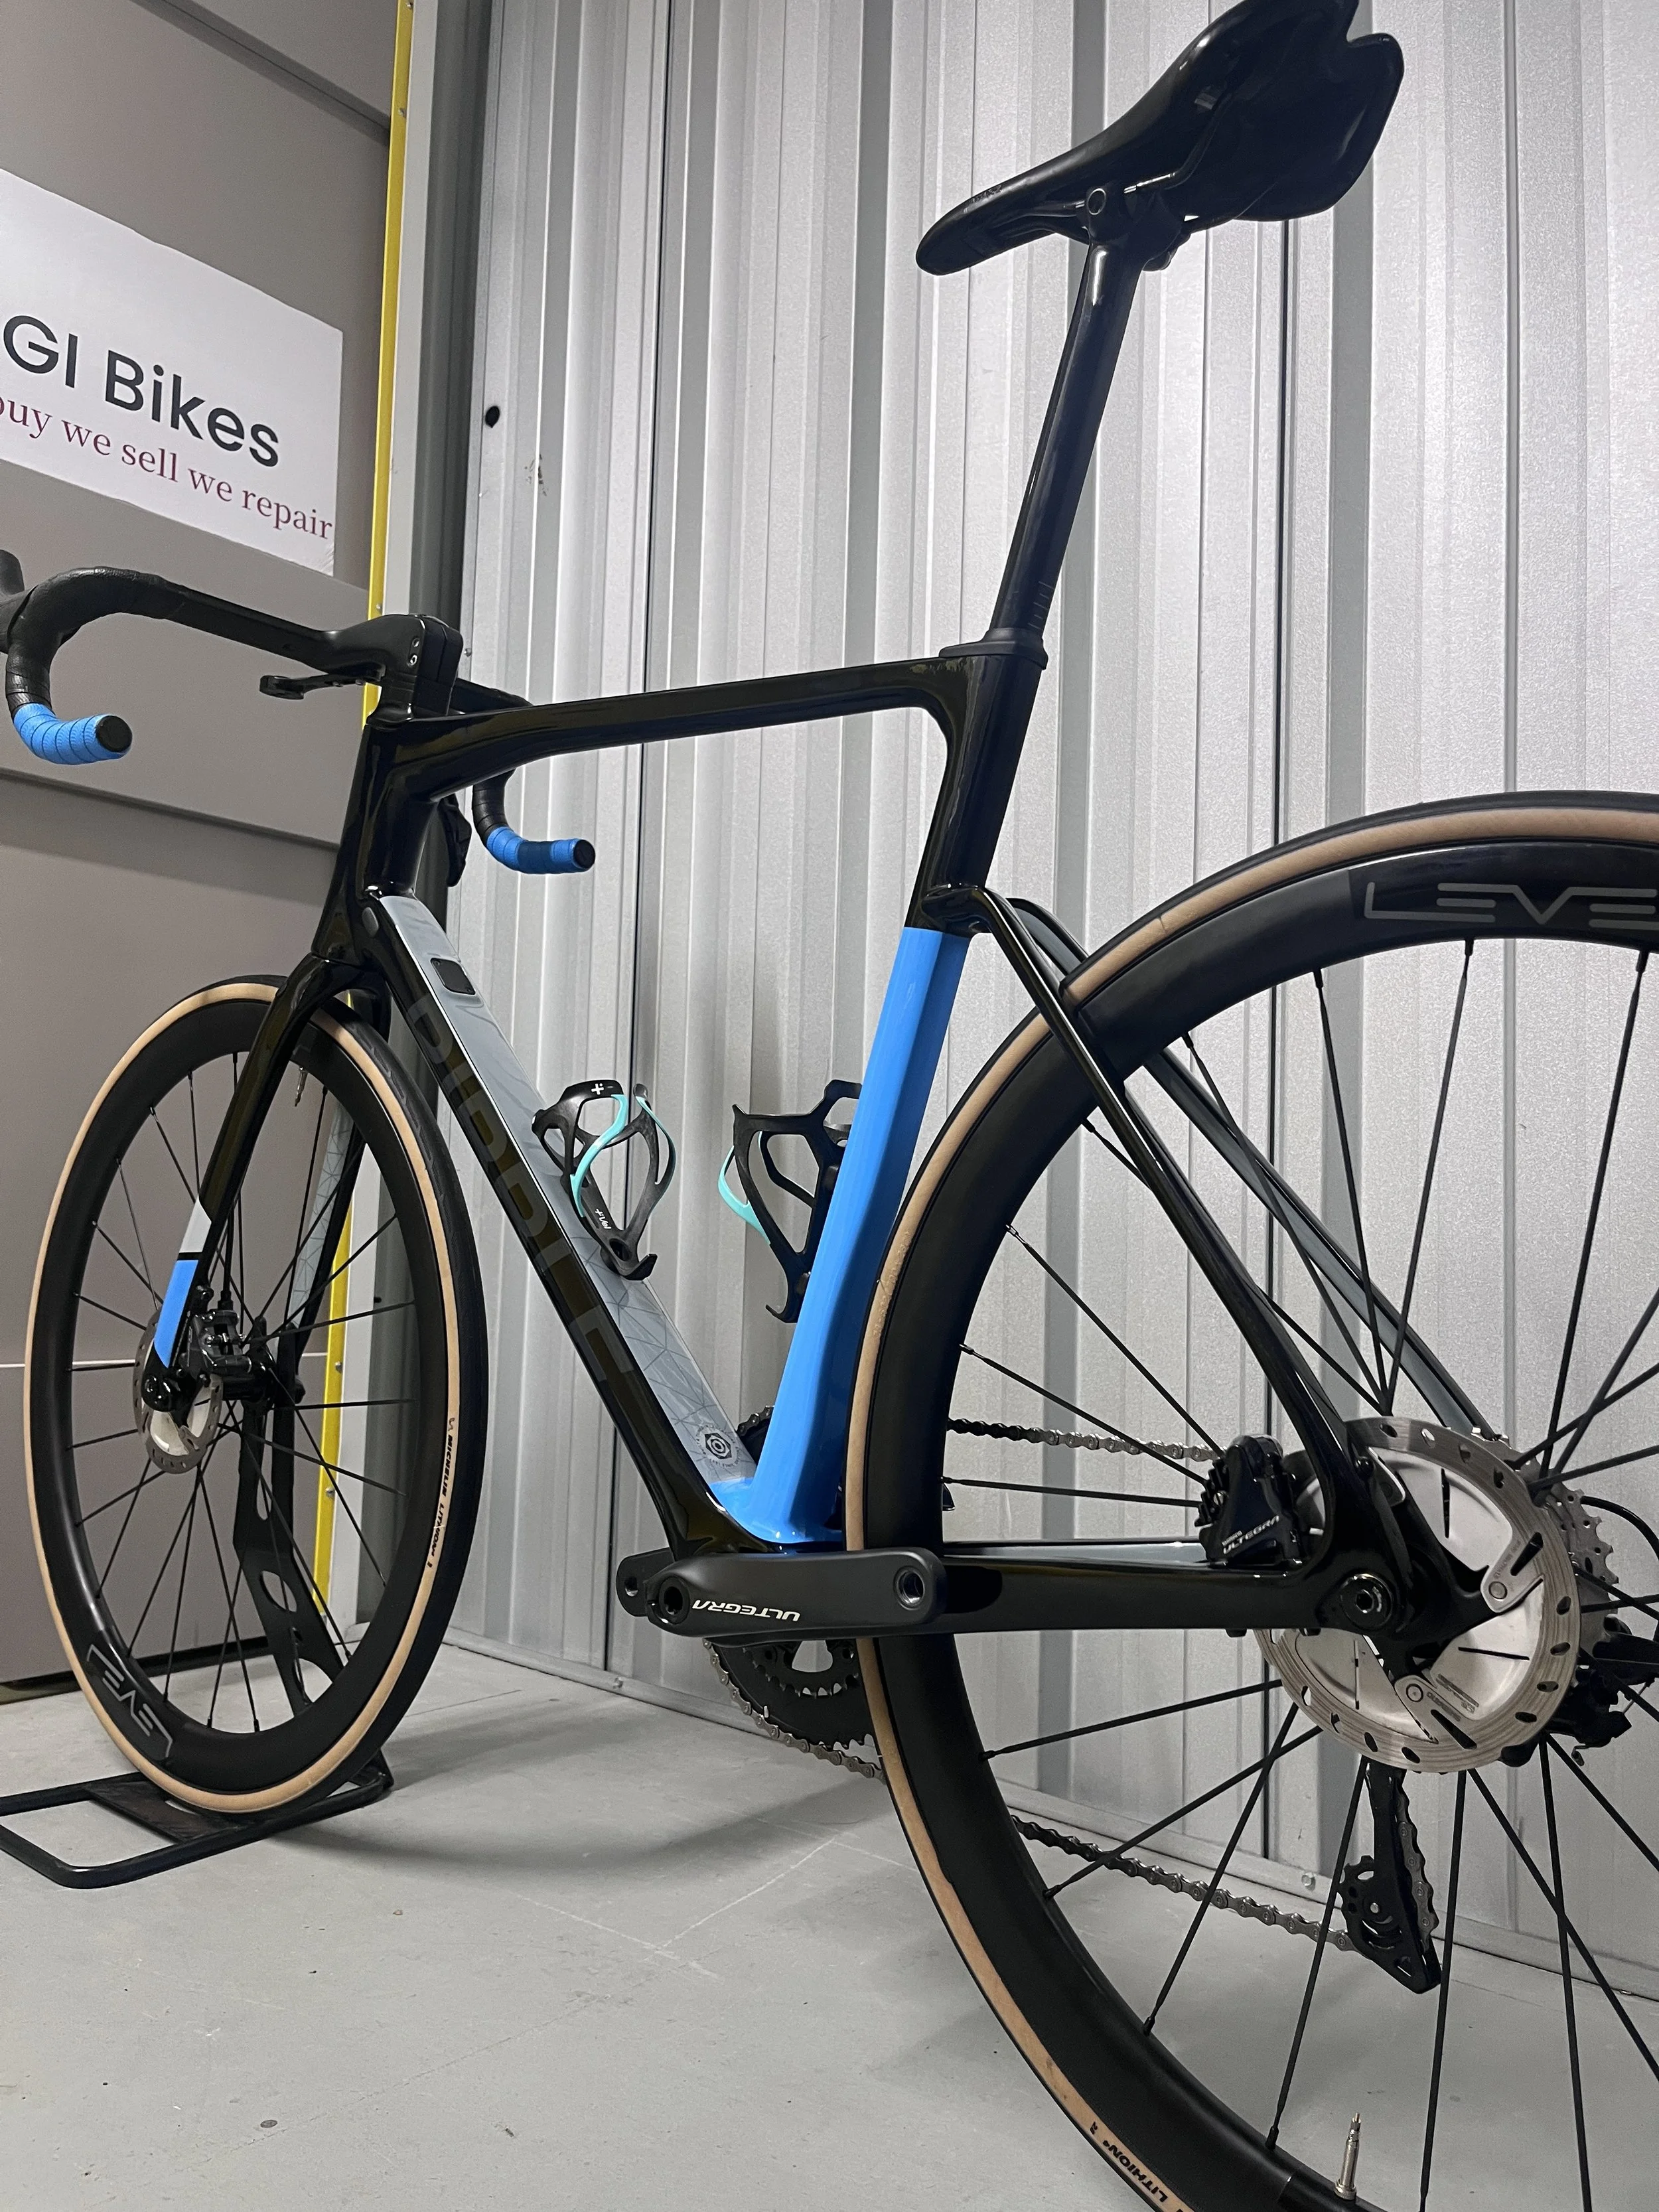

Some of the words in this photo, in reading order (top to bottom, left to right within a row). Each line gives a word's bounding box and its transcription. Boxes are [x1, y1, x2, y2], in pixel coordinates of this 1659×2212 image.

[104, 348, 279, 468] Bikes
[60, 419, 111, 457] we
[121, 444, 179, 484] sell
[187, 468, 234, 503] we
[241, 489, 333, 540] repair
[441, 1434, 453, 1497] MICHELIN
[1222, 1514, 1280, 1556] ULTEGRA
[691, 1598, 800, 1622] ULTEGRA
